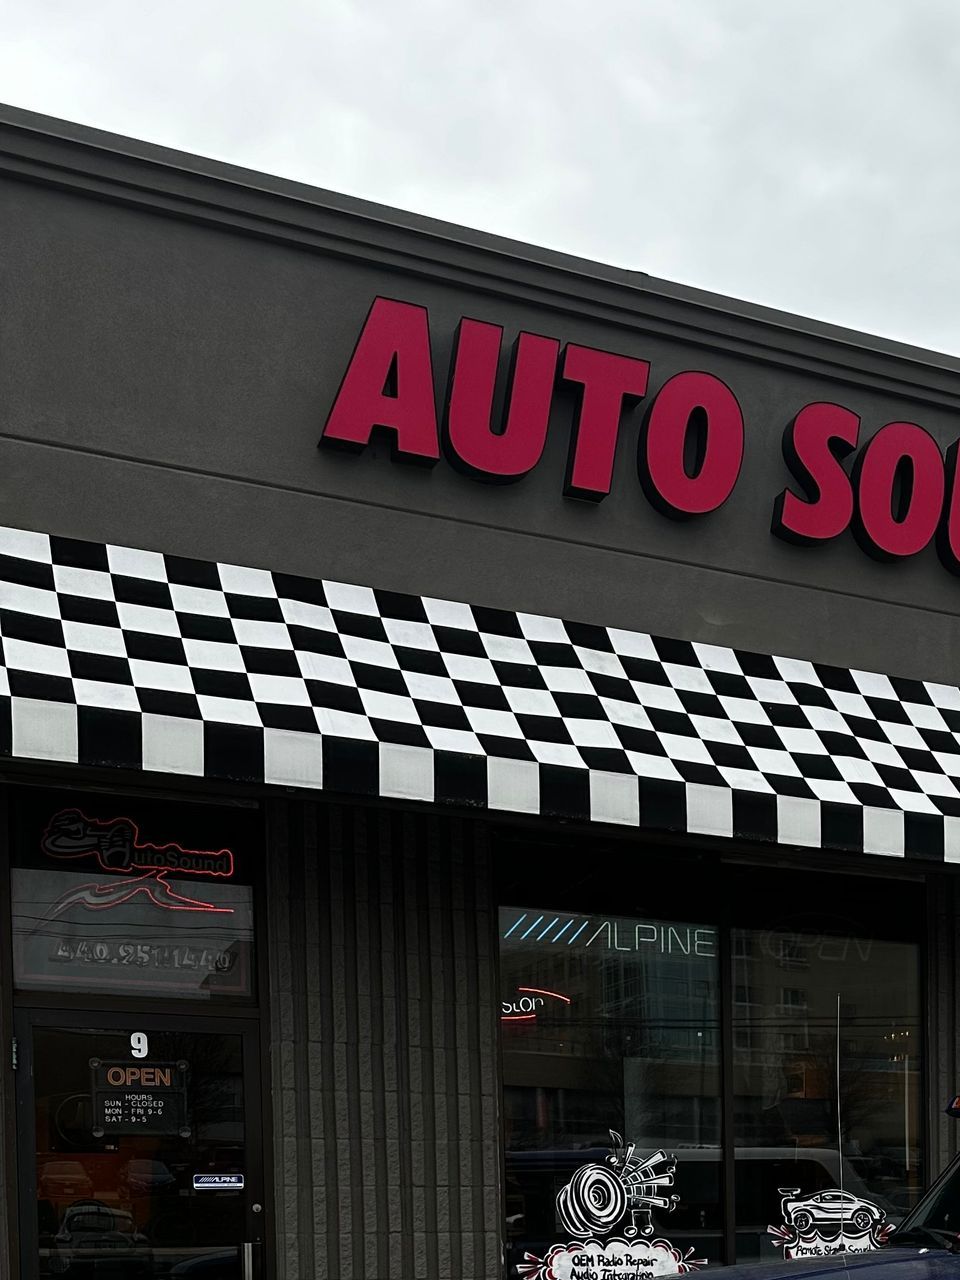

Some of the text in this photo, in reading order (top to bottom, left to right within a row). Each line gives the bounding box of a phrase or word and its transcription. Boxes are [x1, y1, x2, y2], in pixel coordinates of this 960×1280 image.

[318, 296, 745, 522] AUTO
[585, 921, 717, 957] ALPINE
[130, 1031, 149, 1058] 9
[107, 1066, 172, 1087] OPEN
[570, 1267, 598, 1280] Audio
[572, 1253, 658, 1271] OEM Radio Repair
